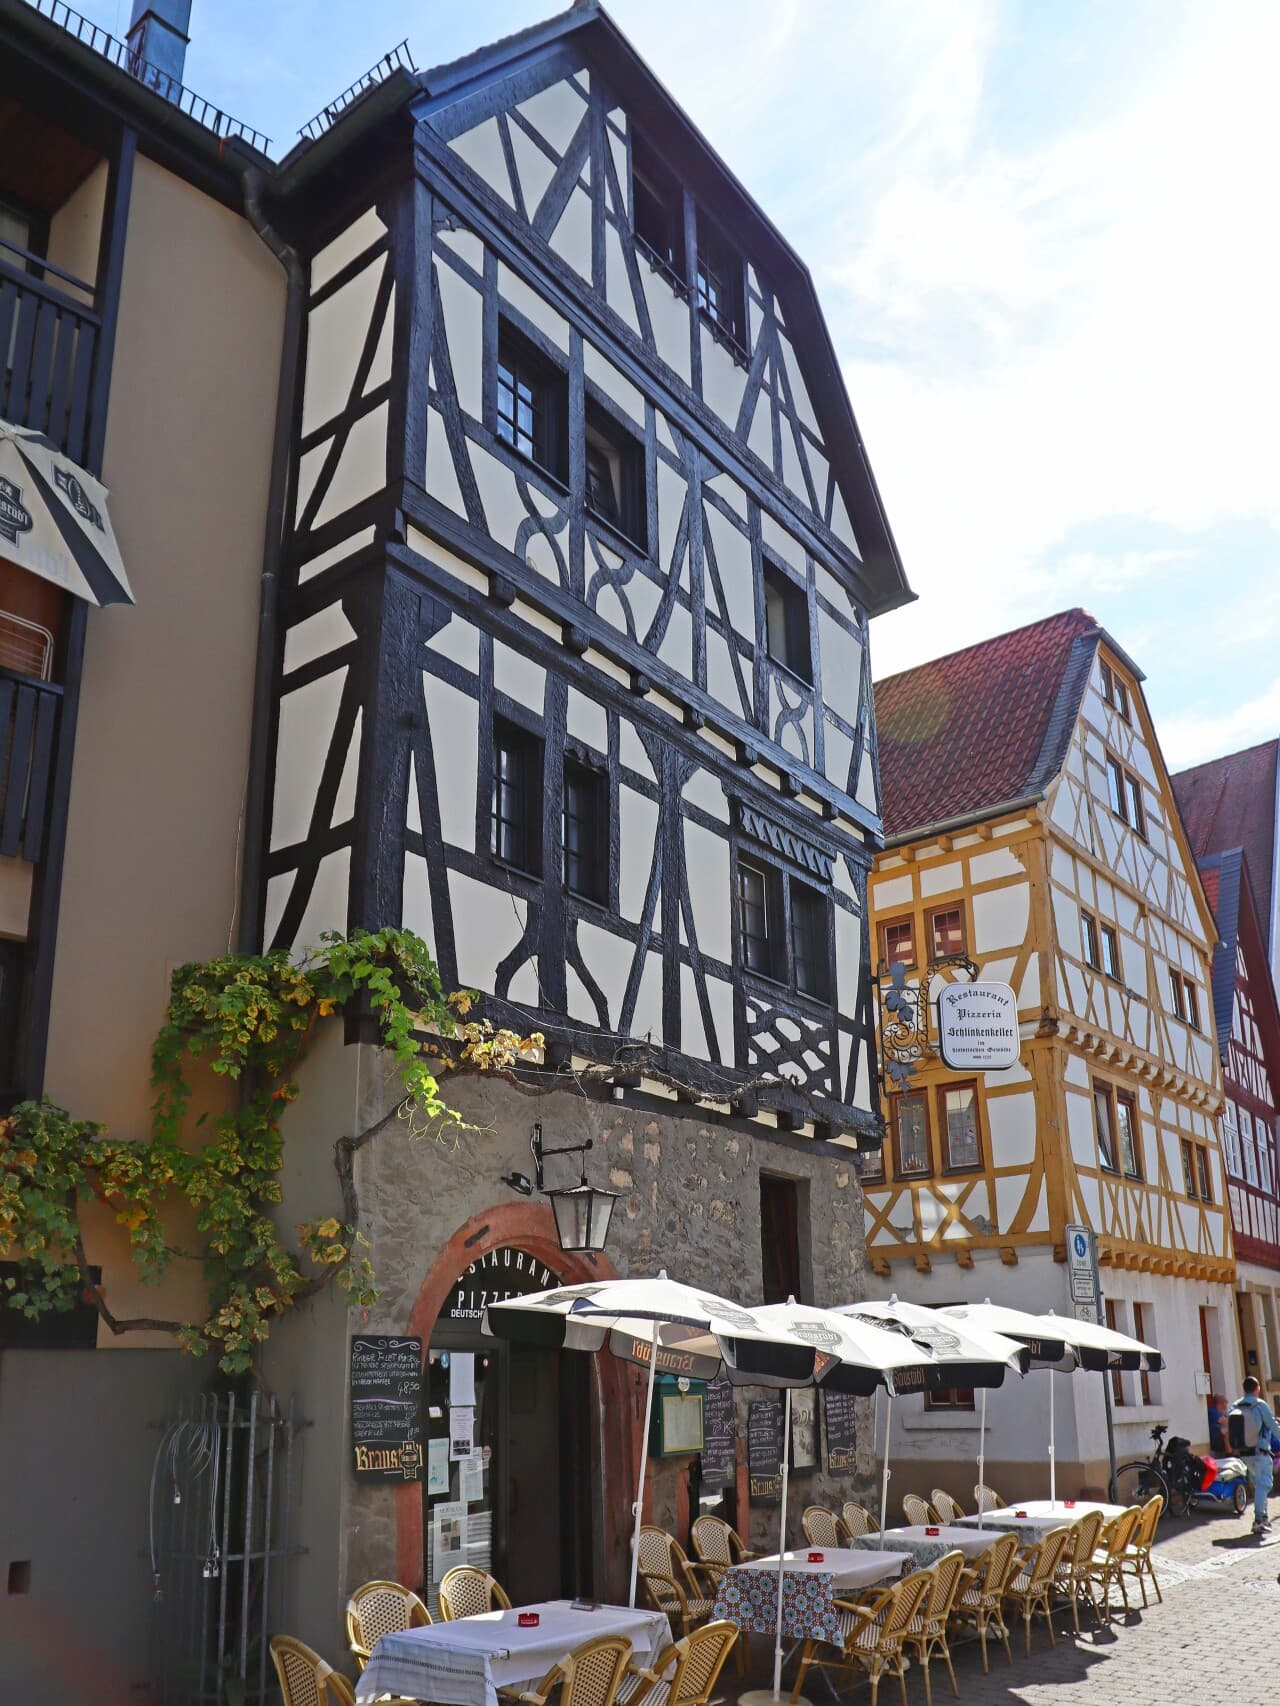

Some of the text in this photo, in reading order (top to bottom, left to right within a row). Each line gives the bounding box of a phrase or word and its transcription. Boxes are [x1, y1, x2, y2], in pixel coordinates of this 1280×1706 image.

[946, 988, 1009, 1007] Restaurant
[957, 1008, 1001, 1020] Pizzeria
[457, 1249, 563, 1289] STAURAN
[450, 1308, 483, 1319] DEUTSCH
[354, 1443, 423, 1471] Braust'l
